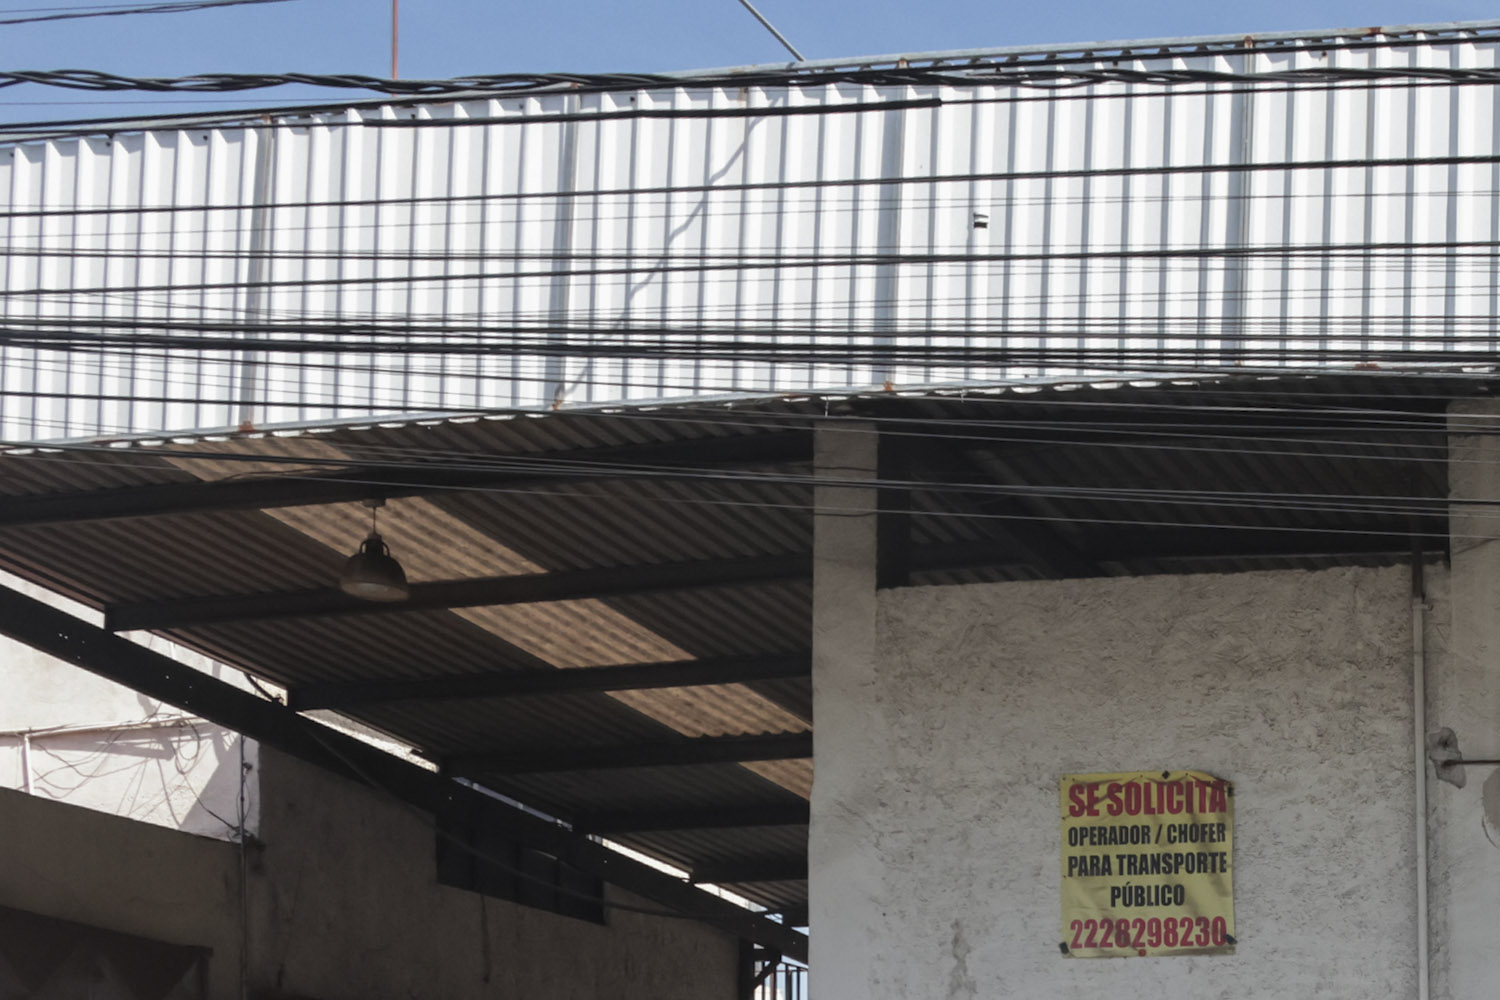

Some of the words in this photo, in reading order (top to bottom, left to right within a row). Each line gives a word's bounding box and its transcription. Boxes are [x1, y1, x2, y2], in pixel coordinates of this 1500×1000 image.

[1068, 782, 1100, 817] SE
[1106, 780, 1227, 817] SOLICITA
[1067, 825, 1151, 847] OPERADOR
[1154, 823, 1163, 845] /
[1166, 822, 1226, 844] CHOFER
[1067, 854, 1113, 878] PARA
[1115, 852, 1228, 876] TRANSPORTE
[1110, 881, 1186, 908] PÚBLICO
[1069, 916, 1227, 949] 2228298230
